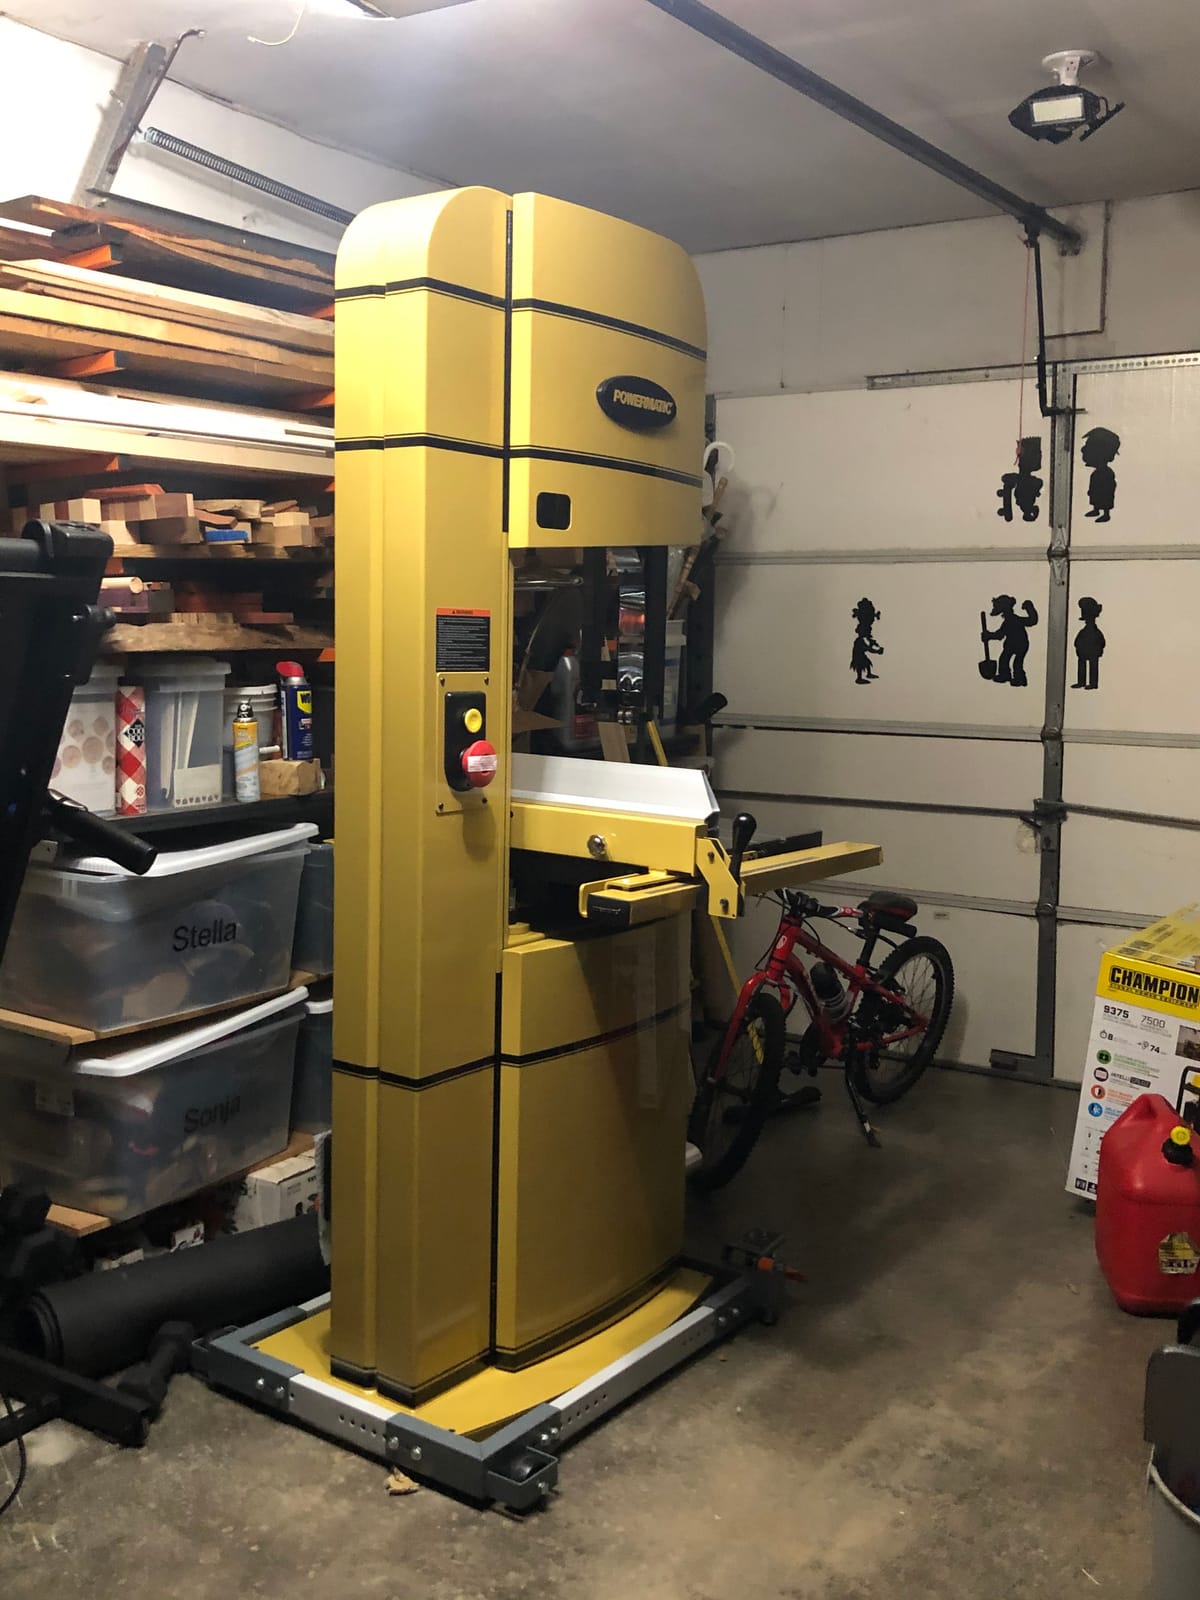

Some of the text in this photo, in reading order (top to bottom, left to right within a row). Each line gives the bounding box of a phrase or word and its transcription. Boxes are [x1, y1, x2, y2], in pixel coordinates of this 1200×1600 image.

[613, 389, 673, 415] POWERMATIC
[172, 918, 237, 952] Stella
[1110, 966, 1199, 1004] CHAMPION
[1103, 1004, 1129, 1019] 9375
[1140, 1014, 1166, 1029] 7500
[1149, 1044, 1160, 1054] 74
[183, 1095, 241, 1134] Sonja
